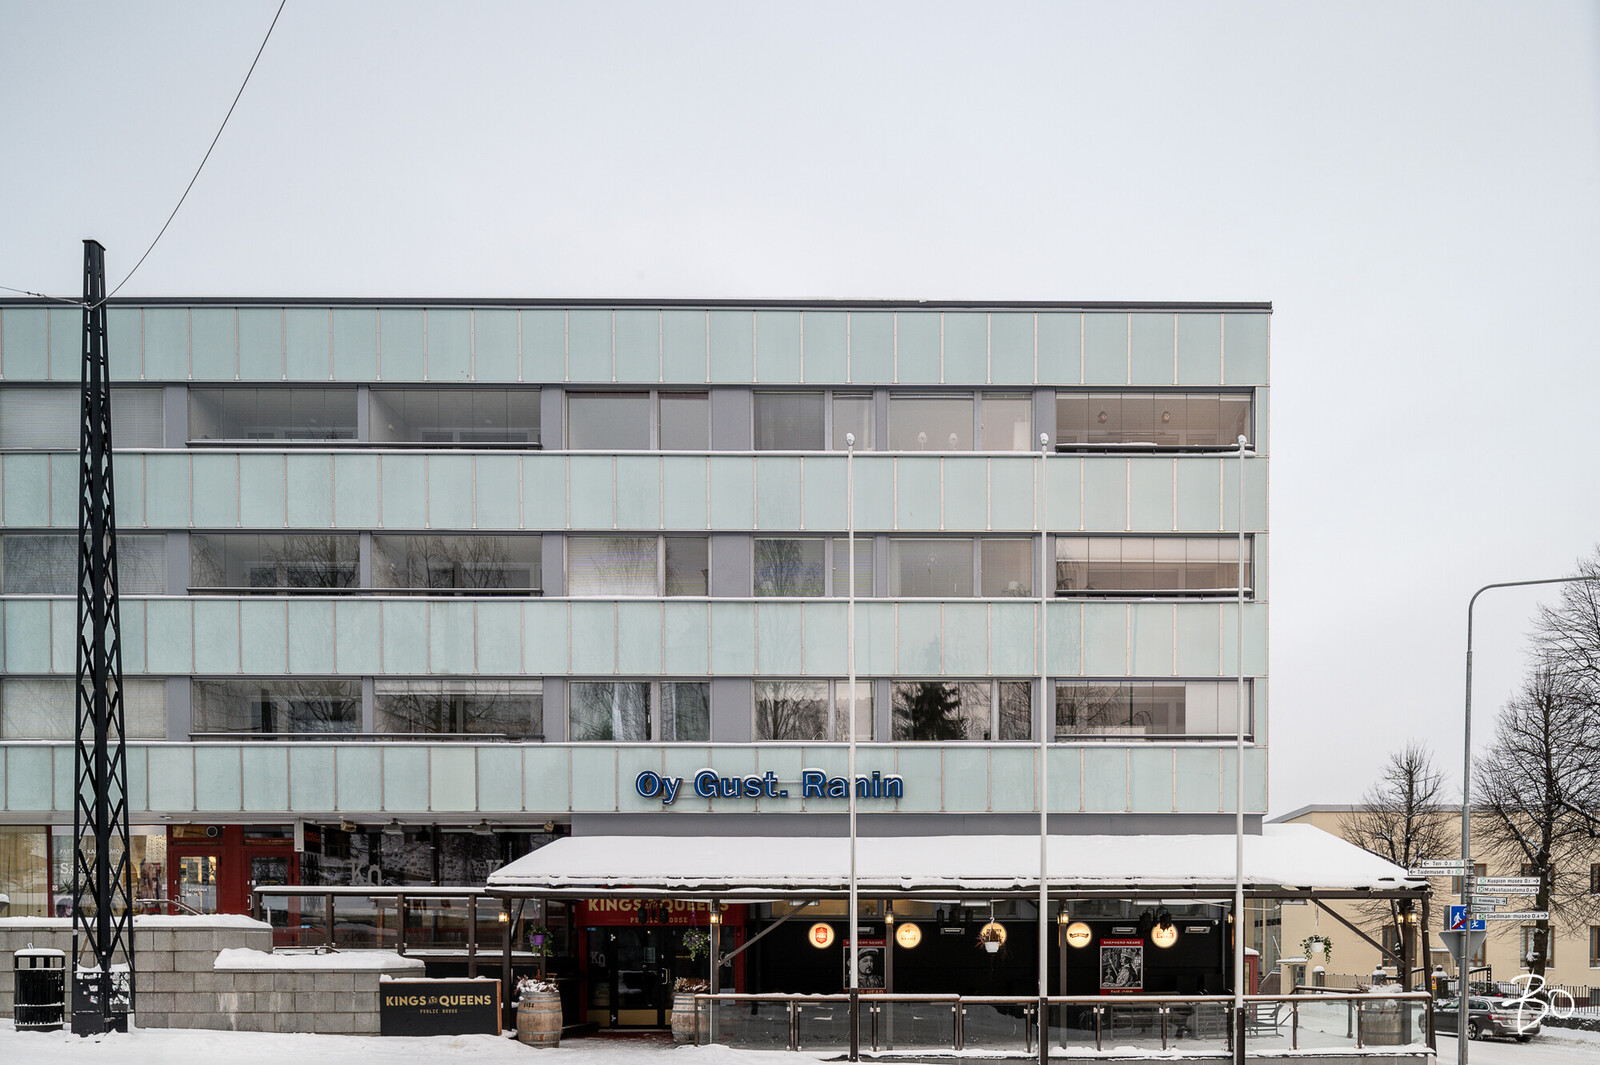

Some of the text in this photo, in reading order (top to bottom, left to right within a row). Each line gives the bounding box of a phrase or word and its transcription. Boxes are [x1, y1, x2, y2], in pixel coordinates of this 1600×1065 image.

[636, 769, 904, 805] Oy Gust. Ranin
[588, 899, 642, 912] KINGS
[385, 996, 427, 1006] KINGS
[438, 995, 492, 1007] QUEENS
